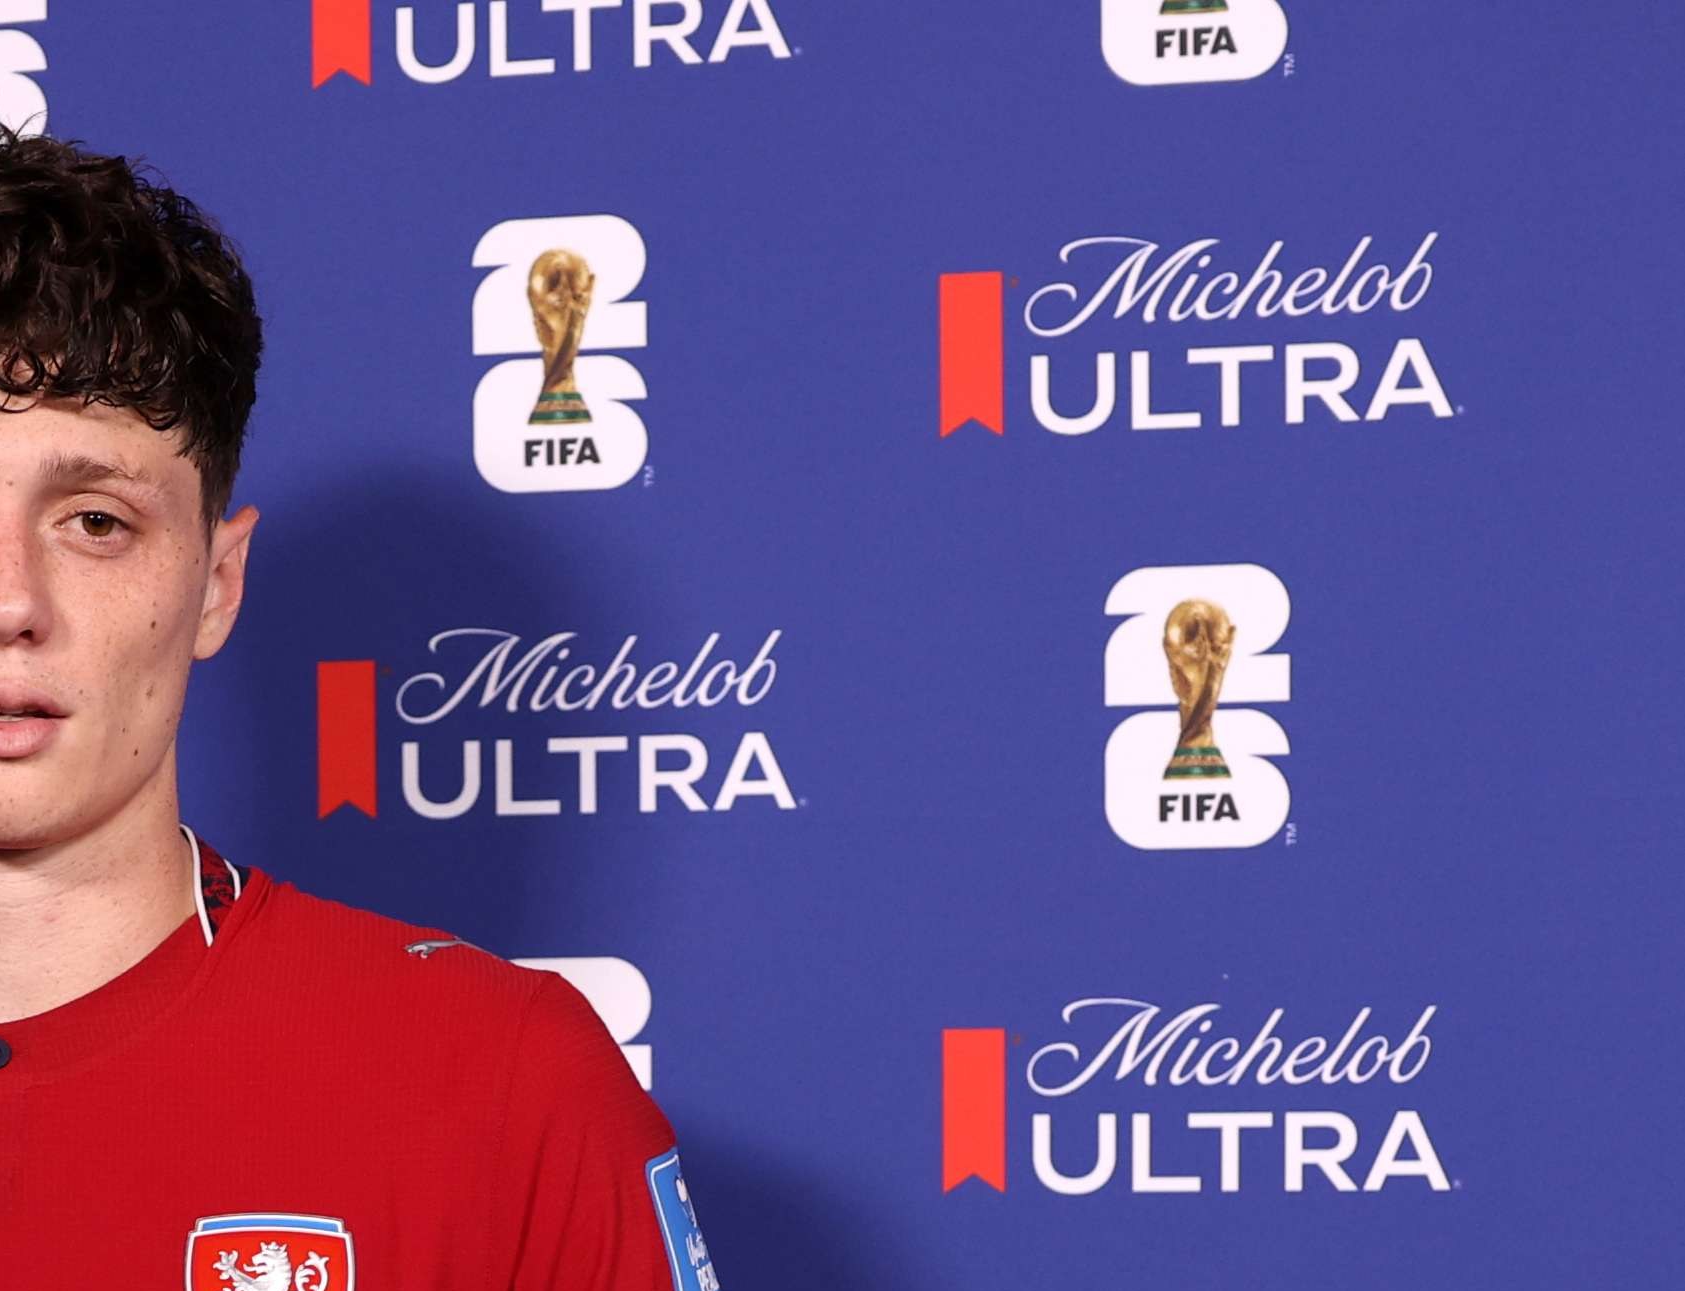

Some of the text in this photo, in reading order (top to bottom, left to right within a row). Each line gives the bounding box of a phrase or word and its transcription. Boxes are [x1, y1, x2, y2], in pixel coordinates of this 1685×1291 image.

[395, 0, 792, 84] ULTRA
[1155, 27, 1237, 58] FIFA
[1024, 232, 1439, 338] Michelob
[1030, 338, 1454, 436] ULTRA
[524, 438, 601, 467] FIFA
[396, 628, 782, 725] Michelob
[402, 732, 796, 819] ULTRA
[1159, 793, 1240, 823] FIFA
[1027, 998, 1437, 1096] Michelob
[1032, 1110, 1450, 1195] ULTRA
